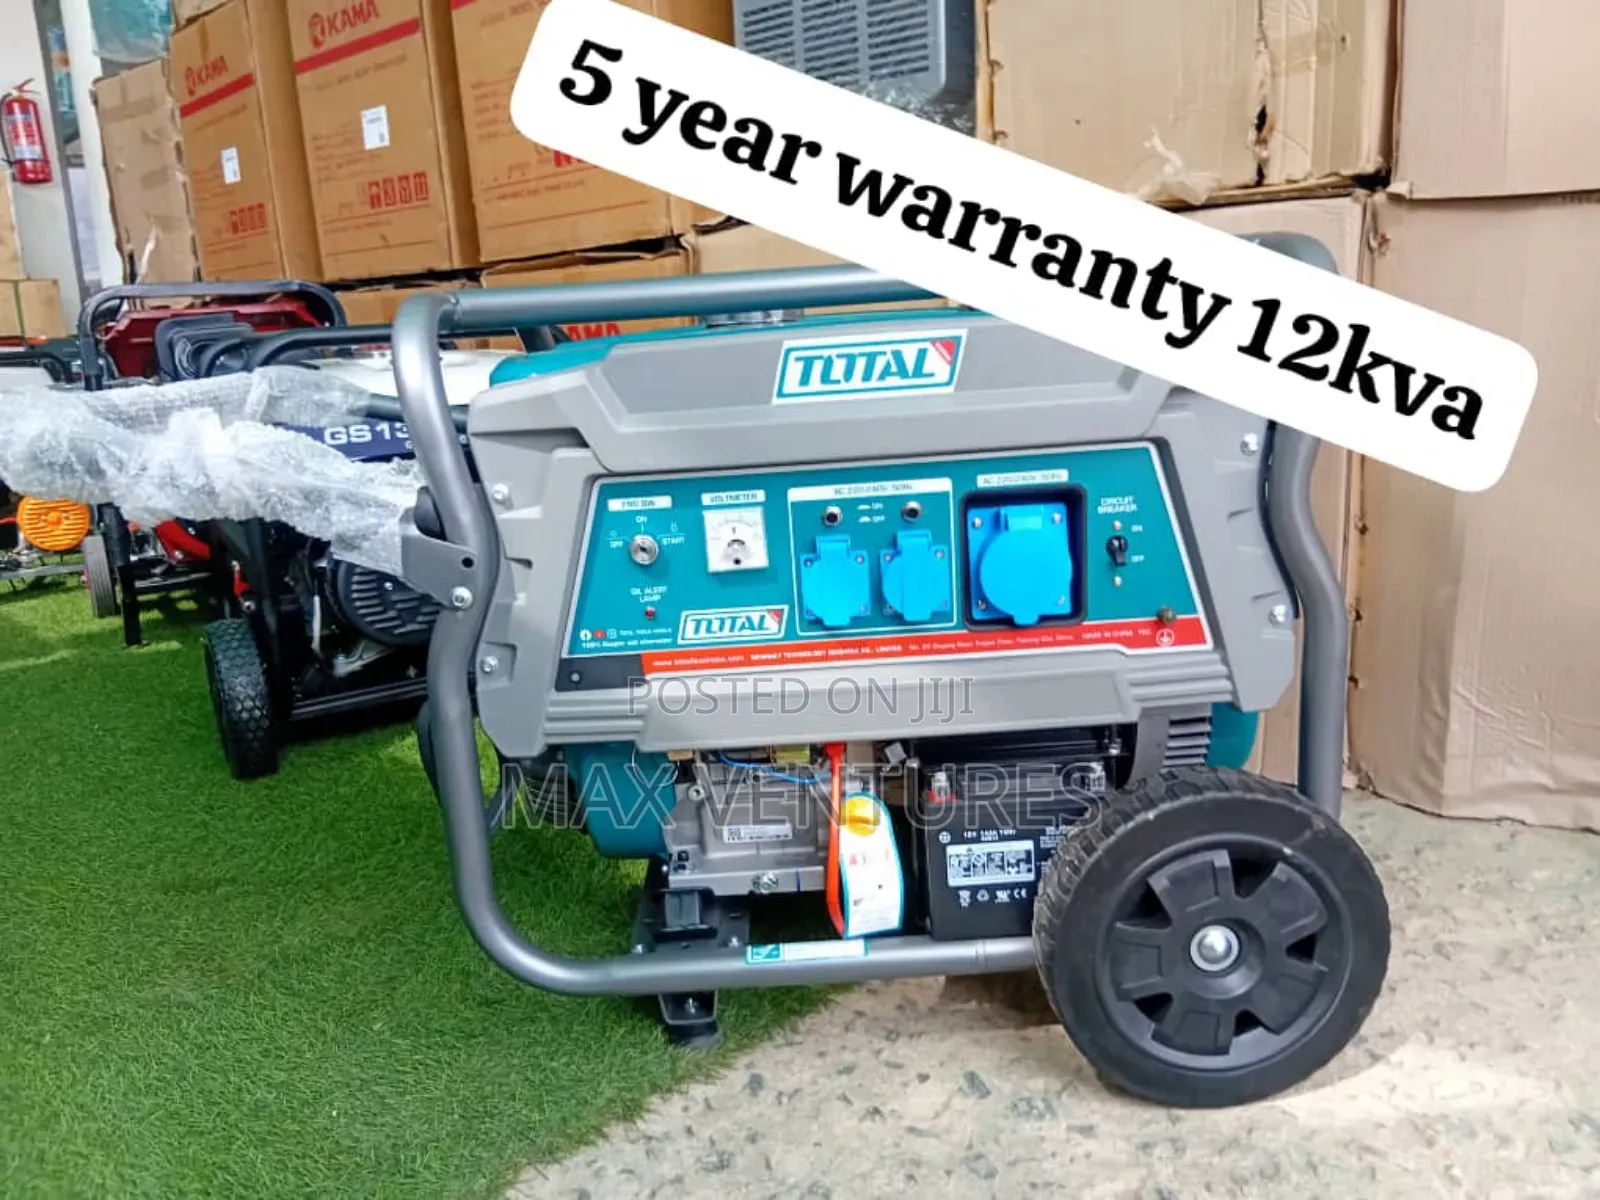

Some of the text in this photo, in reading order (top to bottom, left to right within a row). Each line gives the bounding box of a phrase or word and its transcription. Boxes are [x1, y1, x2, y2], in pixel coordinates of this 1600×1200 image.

[326, 0, 380, 35] KAMA
[198, 55, 228, 86] KAMA
[794, 347, 937, 387] TOTAL
[709, 492, 758, 504] VOLTMETER
[1100, 495, 1134, 506] CIRCUIT
[1097, 503, 1138, 514] BREAKER
[635, 515, 648, 524] ON
[1131, 524, 1143, 532] ON
[1131, 555, 1145, 563] OFF
[689, 613, 773, 637] TOTAL
